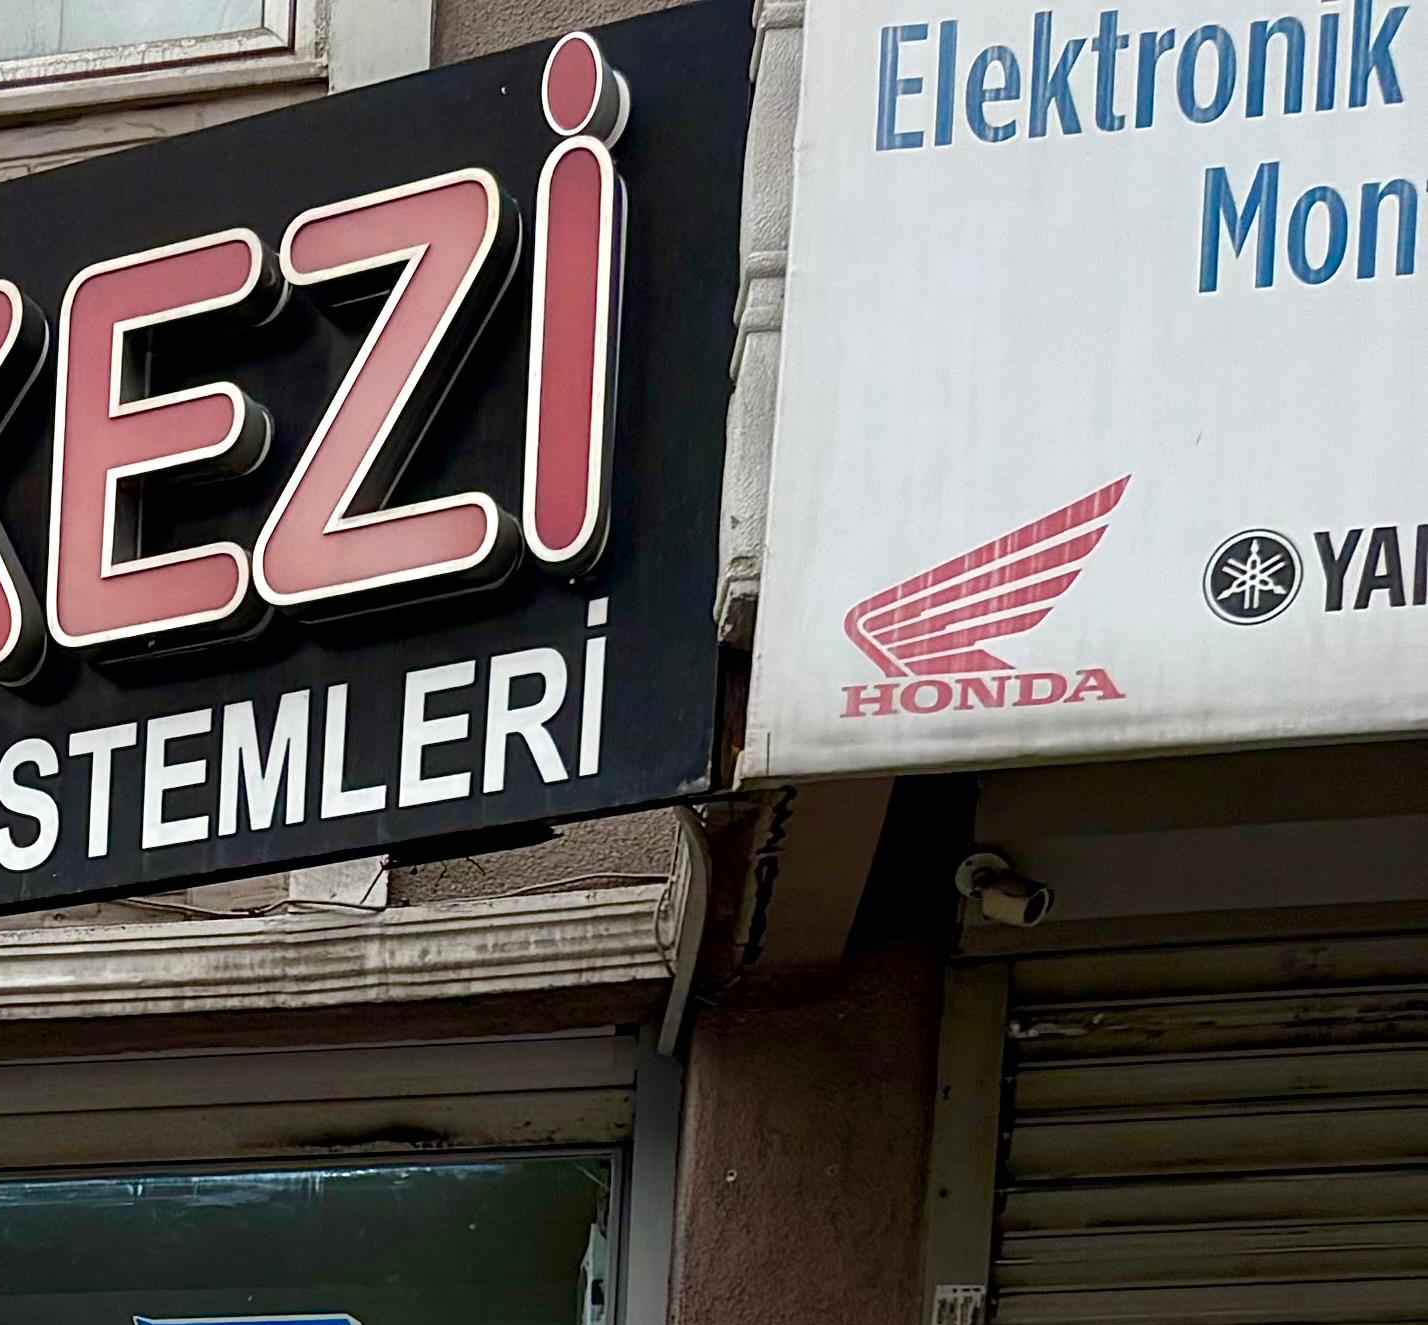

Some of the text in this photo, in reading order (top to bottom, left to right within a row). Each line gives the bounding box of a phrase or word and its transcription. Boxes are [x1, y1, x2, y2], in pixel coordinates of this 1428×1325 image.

[875, 0, 1411, 152] Elektronik
[1198, 161, 1428, 293] Mon
[839, 667, 1126, 718] HONDA
